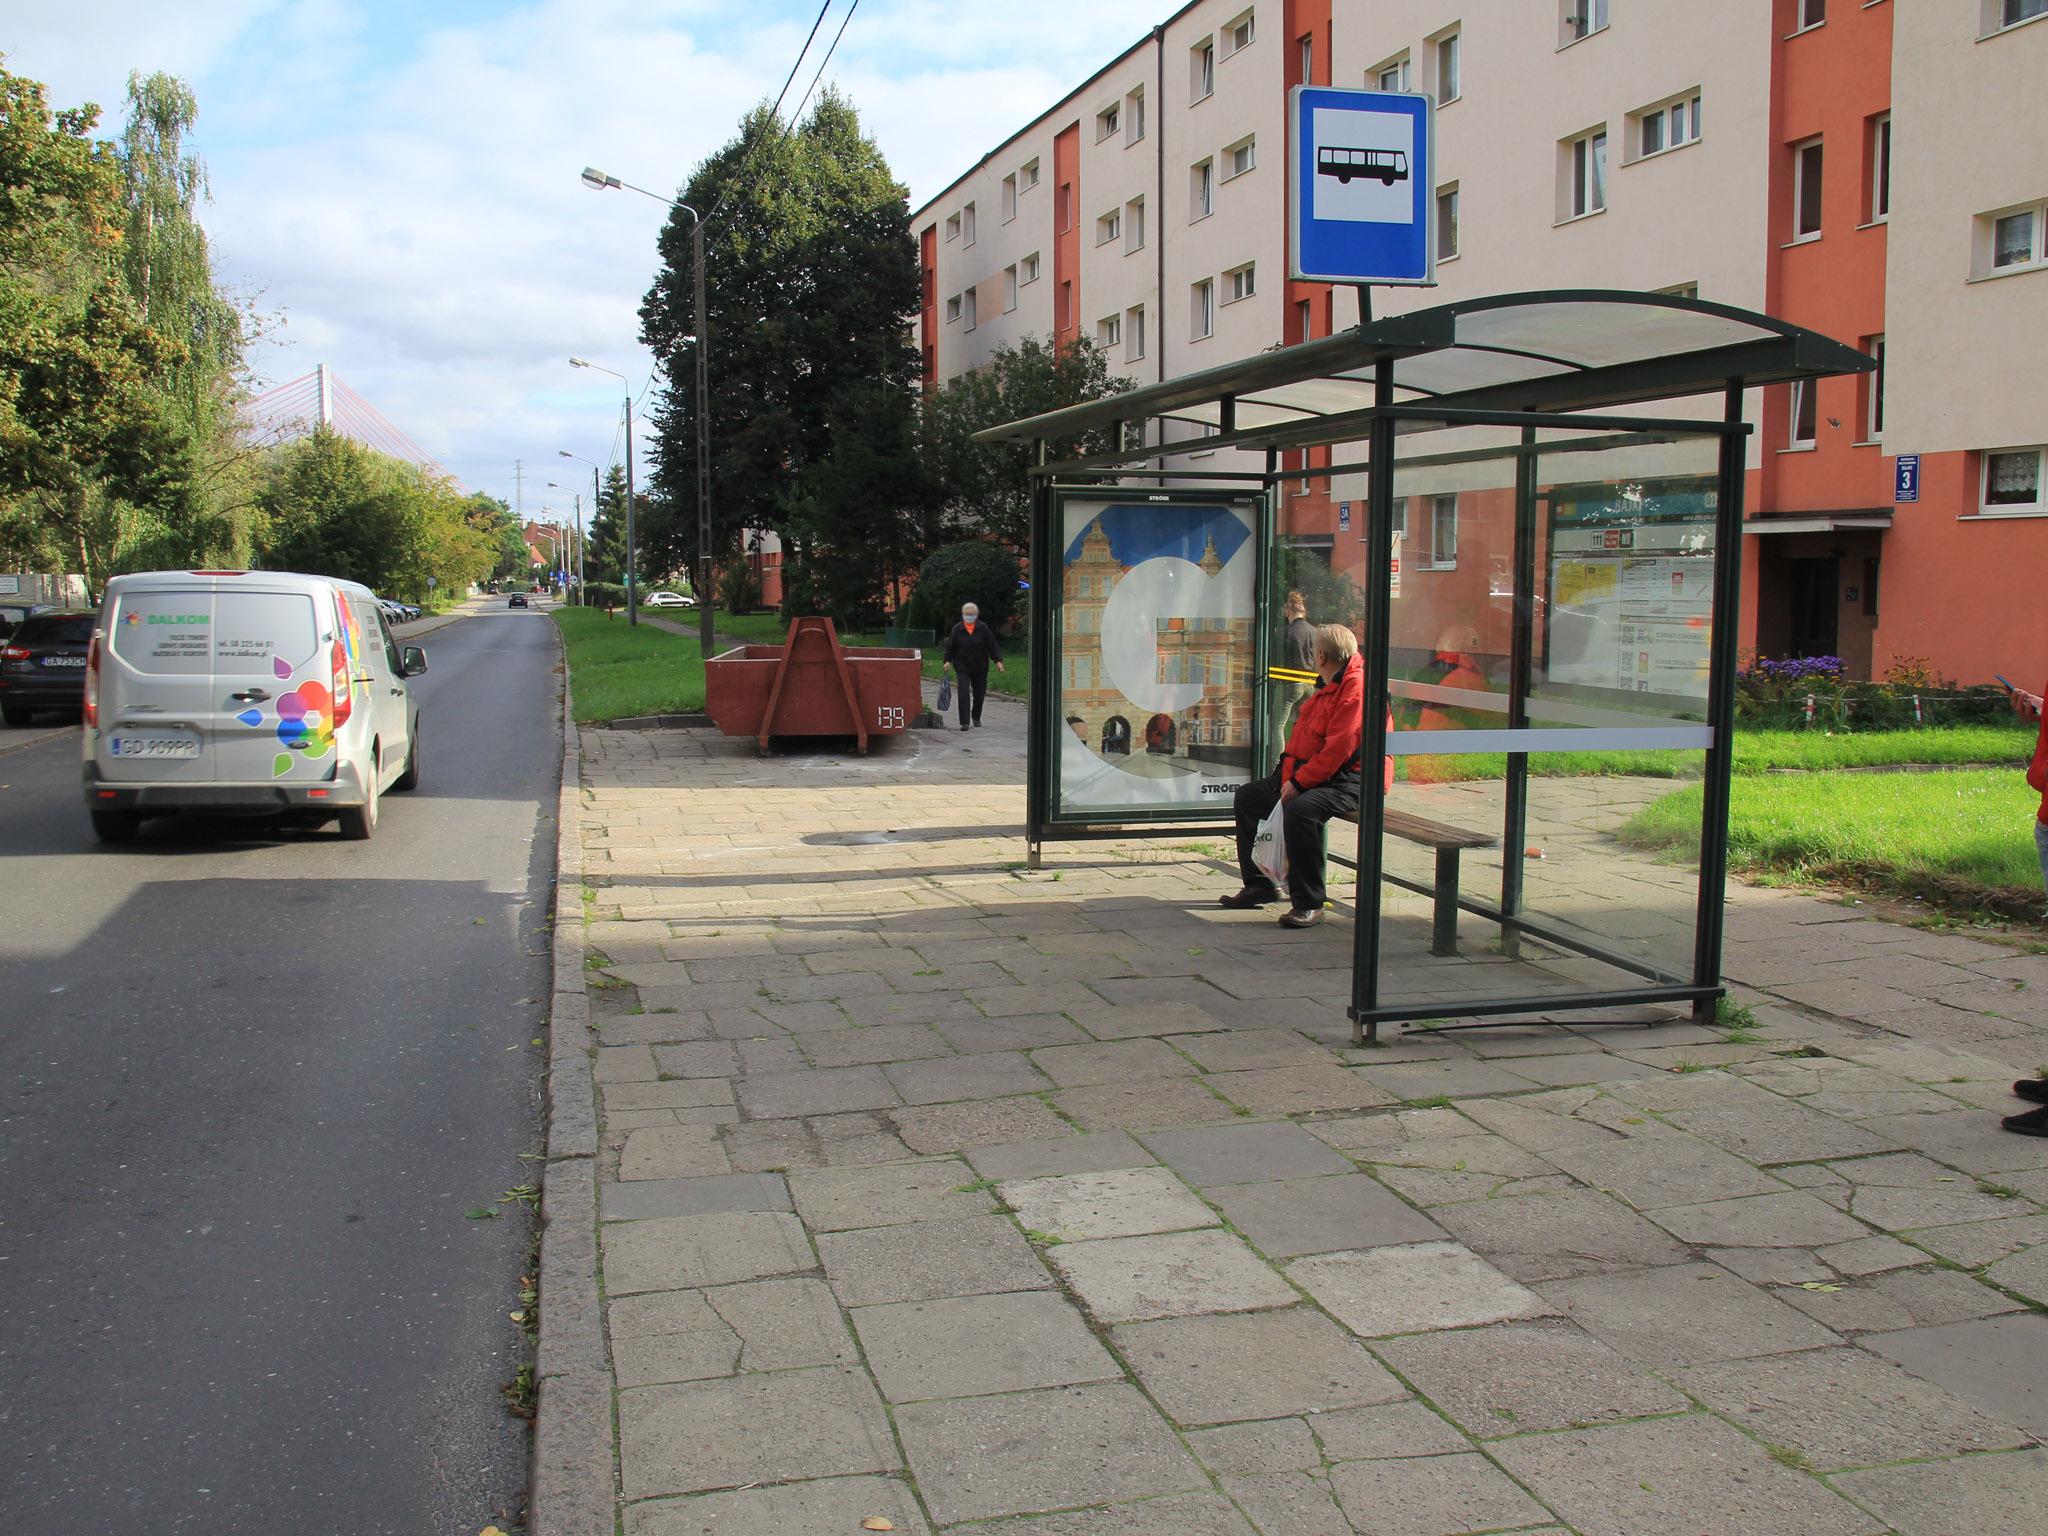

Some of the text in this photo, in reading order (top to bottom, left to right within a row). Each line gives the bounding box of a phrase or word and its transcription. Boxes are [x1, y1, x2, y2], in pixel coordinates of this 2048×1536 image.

[1902, 471, 1910, 489] 3
[147, 614, 209, 625] DALKOM
[122, 739, 144, 754] GD
